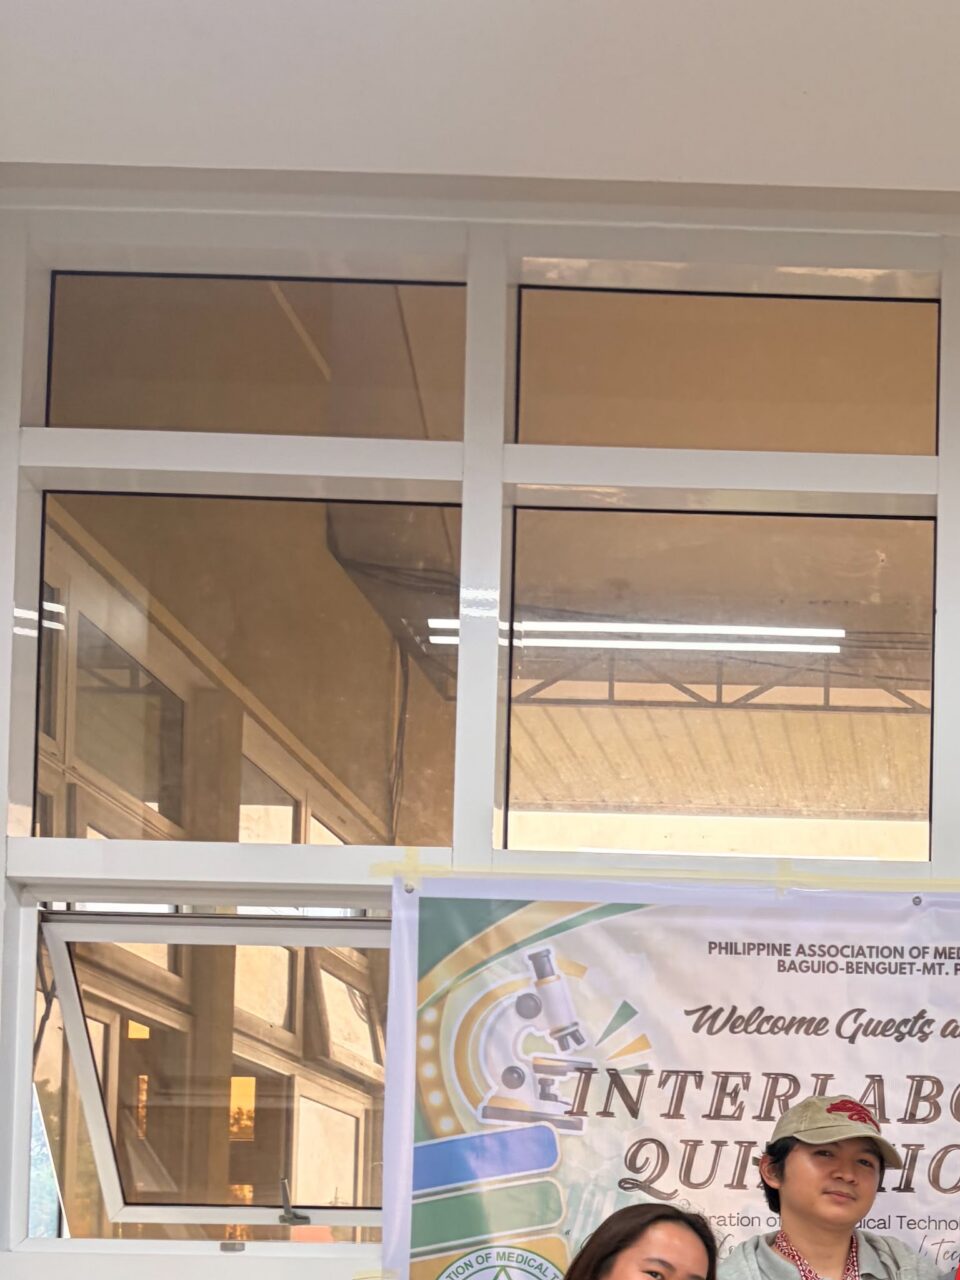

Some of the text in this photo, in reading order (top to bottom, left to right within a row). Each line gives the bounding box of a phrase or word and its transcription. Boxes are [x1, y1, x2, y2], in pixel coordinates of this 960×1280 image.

[708, 941, 792, 957] PHILIPPINE
[795, 943, 905, 960] ASSOCIATION
[908, 945, 930, 960] OF
[777, 959, 950, 976] BAGUIO-BENGUET-MT.
[684, 1004, 830, 1036] Welcome
[835, 1007, 936, 1044] Guests
[618, 1138, 770, 1200] QUI
[707, 1212, 761, 1228] ration
[475, 1252, 492, 1266] OF
[495, 1251, 549, 1278] MEDICAL
